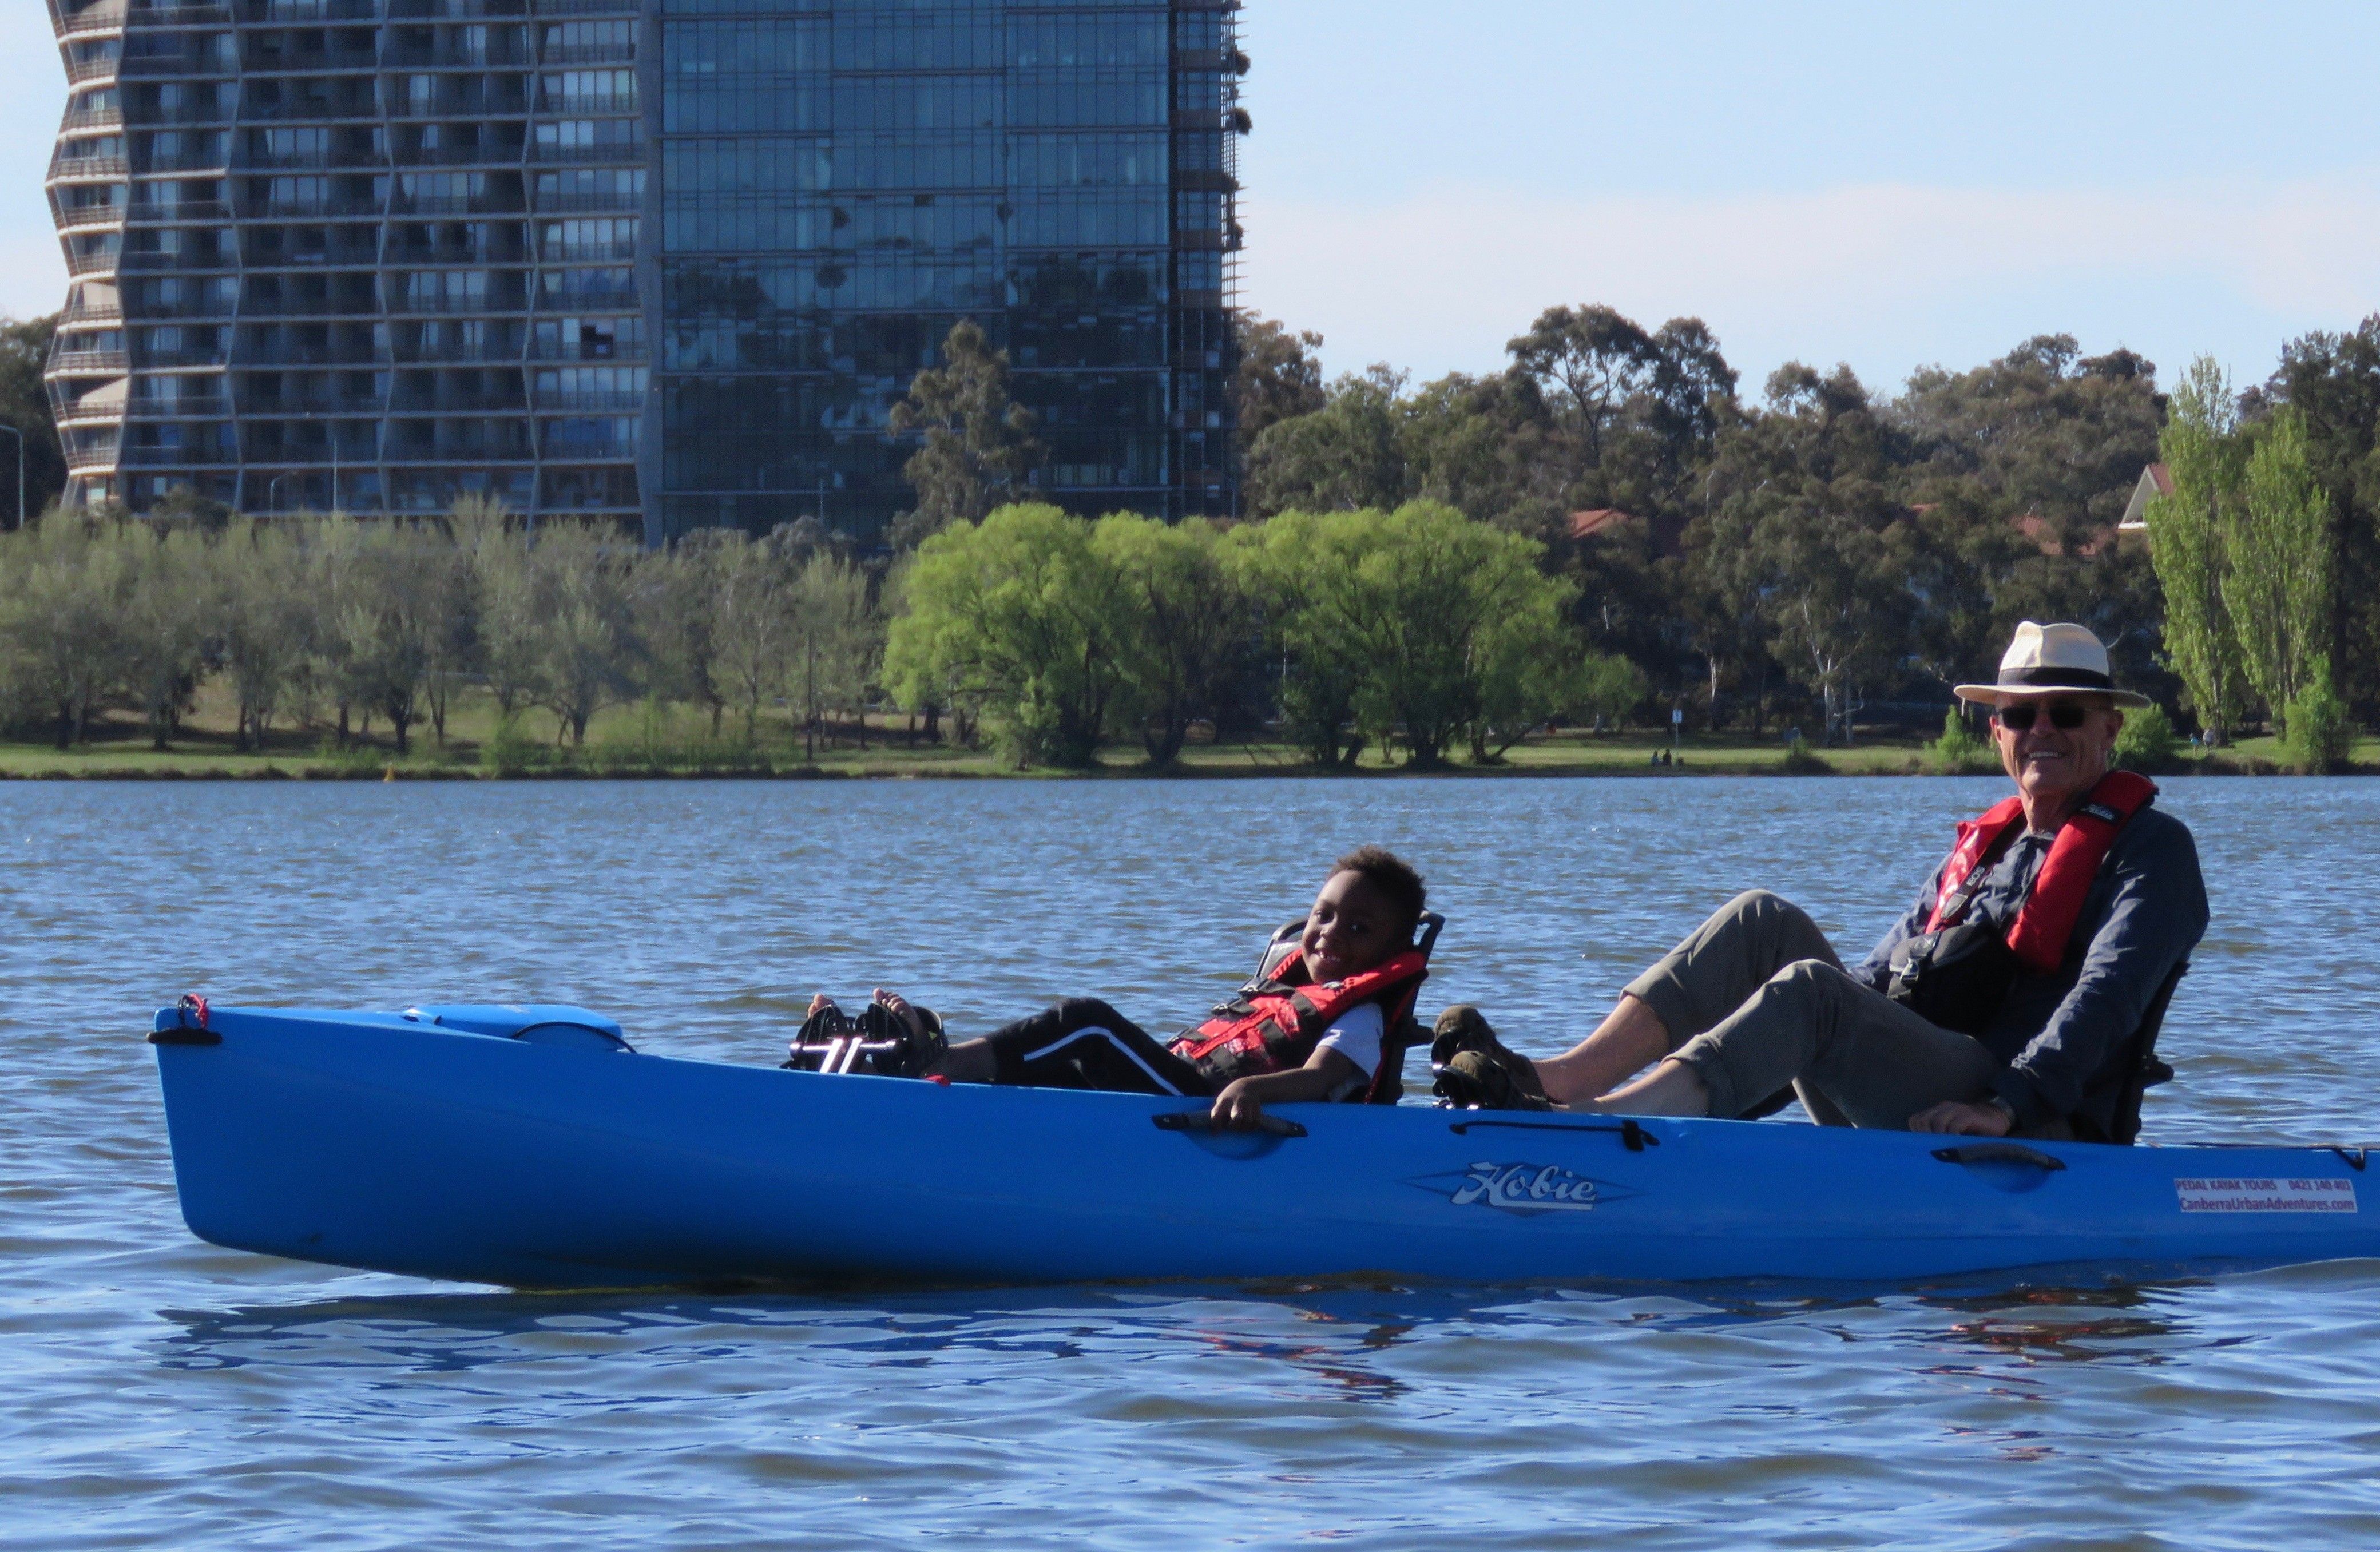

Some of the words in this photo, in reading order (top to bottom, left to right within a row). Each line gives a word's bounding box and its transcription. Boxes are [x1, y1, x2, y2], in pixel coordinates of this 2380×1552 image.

[1450, 1162, 1597, 1210] Hobie
[2176, 1180, 2208, 1190] PEDAL
[2210, 1180, 2241, 1190] KAYAK
[2243, 1180, 2278, 1190] TOURS
[2180, 1197, 2354, 1210] CanberraUrbanAdventures.com
